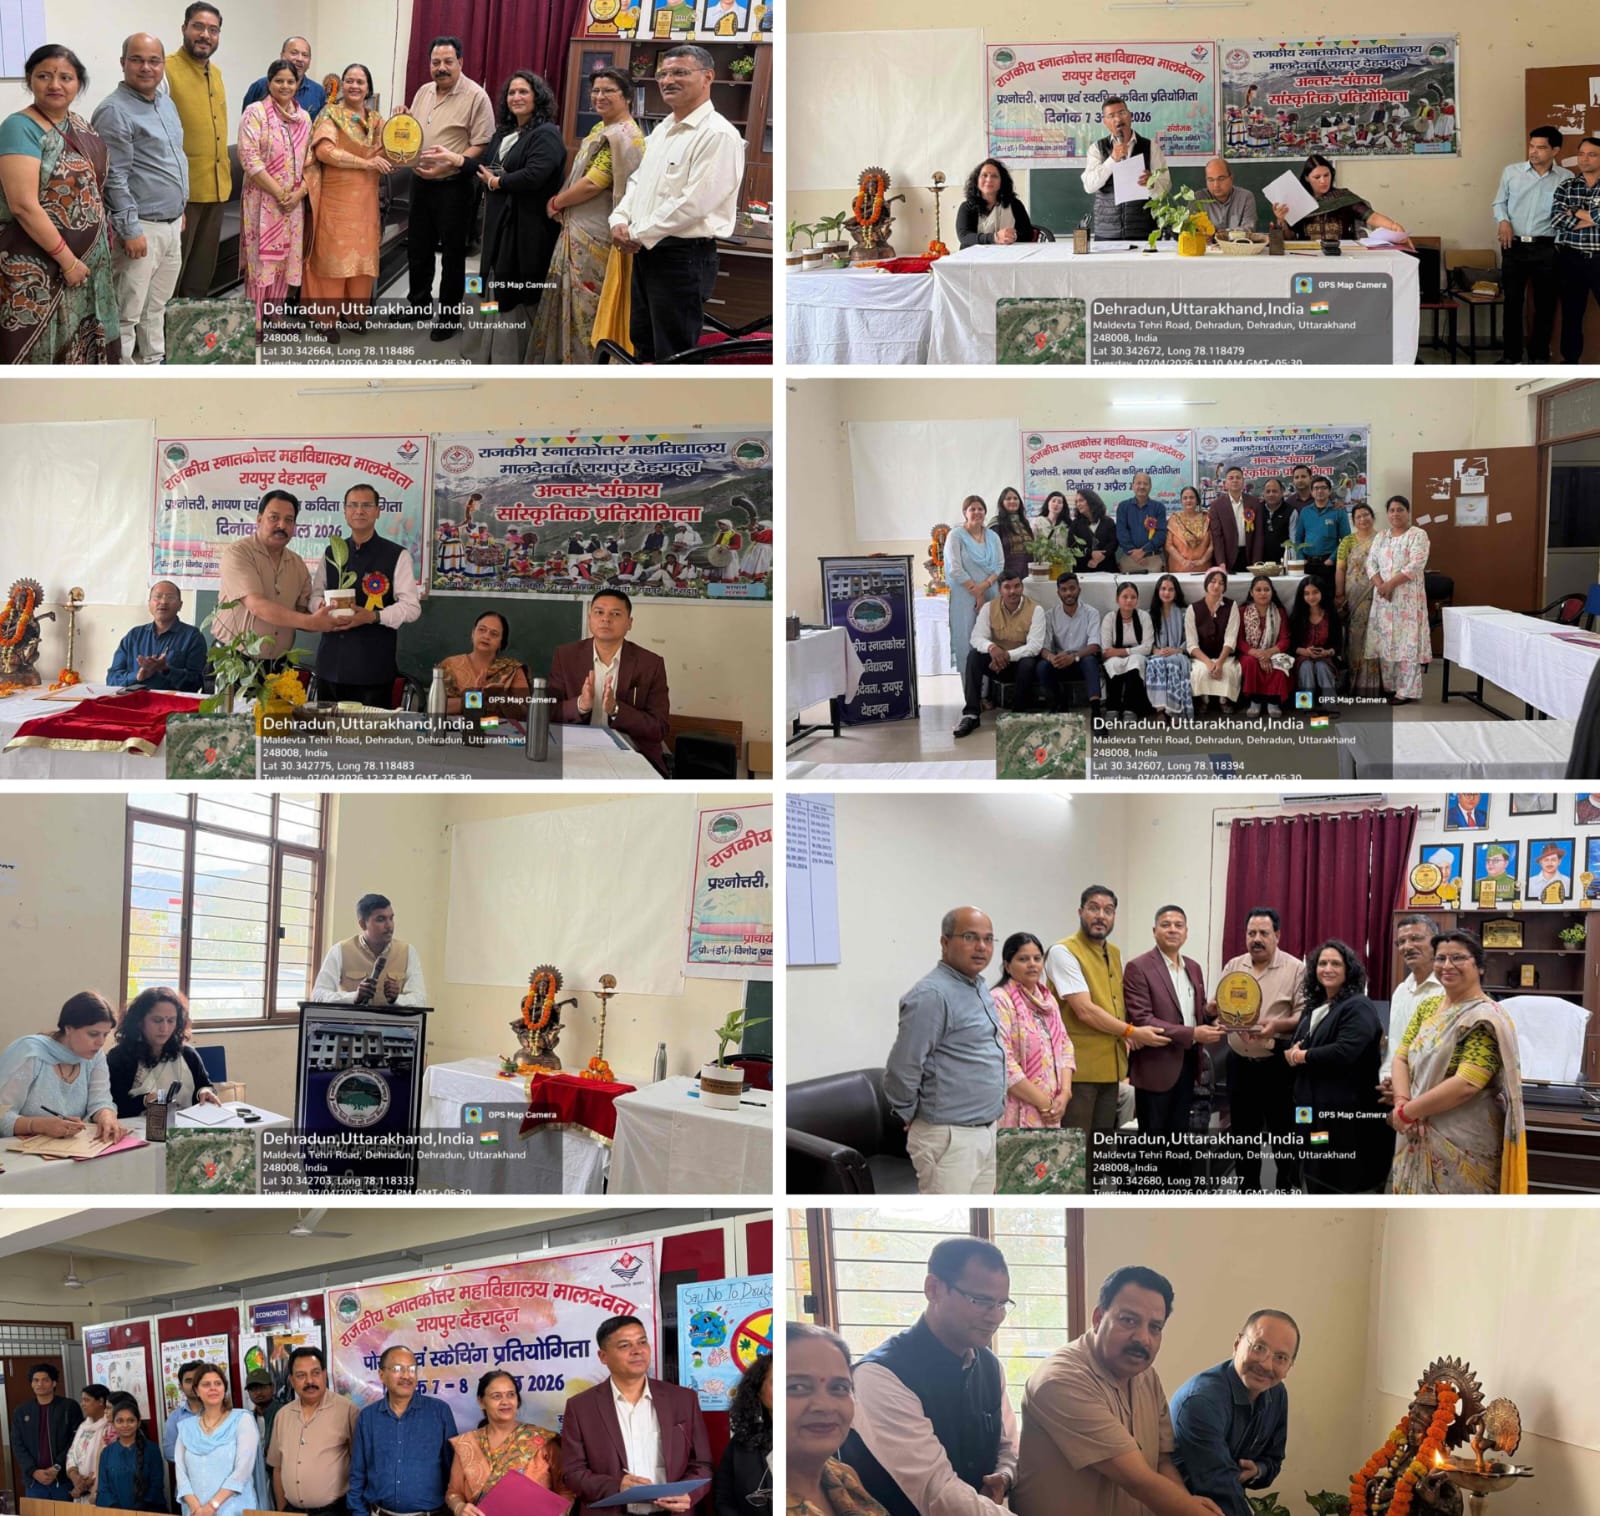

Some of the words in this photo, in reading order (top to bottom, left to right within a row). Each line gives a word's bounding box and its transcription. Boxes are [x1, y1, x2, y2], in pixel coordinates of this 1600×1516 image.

[994, 61, 1036, 88] राजकीय
[1038, 51, 1092, 69] स्नातकोत्तर
[1095, 49, 1154, 66] महाविद्यालय
[1157, 58, 1206, 84] मालदेवता
[1062, 70, 1093, 86] रायपुर
[1096, 68, 1136, 85] देहरादून
[1044, 109, 1082, 124] दिनांक
[478, 443, 538, 459] राजकीय
[542, 441, 627, 458] स्नातकोत्तर
[630, 438, 727, 456] महाविद्यालय
[164, 460, 210, 490] राजकीय
[213, 447, 276, 471] स्नातकोत्तर
[279, 445, 352, 468] महाविद्यालय
[354, 456, 414, 490] मालदेवता
[240, 471, 275, 490] रायपुर
[278, 472, 326, 490] देहरादून
[534, 479, 662, 500] अन्तर-संकाय
[212, 499, 240, 512] भाषण
[305, 497, 339, 512] कविता
[495, 503, 591, 526] सांस्कृतिक
[593, 502, 704, 526] प्रतियोगिता
[708, 829, 773, 869] राजकीय
[708, 870, 769, 892] प्रश्नोत्तरी,
[706, 1287, 722, 1300] No
[256, 1310, 287, 1318] ECONOMICS
[339, 1305, 384, 1348] राजकीय
[386, 1287, 456, 1319] स्नातकोत्तर
[460, 1276, 550, 1304] महाविद्यालय
[554, 1283, 638, 1317] मालदेवता
[416, 1311, 456, 1338] रायपुर
[460, 1305, 519, 1334] देहरादून
[430, 1342, 488, 1367] स्केचिंग
[493, 1336, 591, 1366] प्रतियोगिता
[432, 1379, 439, 1394] 7
[460, 1378, 468, 1394] 8
[528, 1374, 565, 1392] 2026
